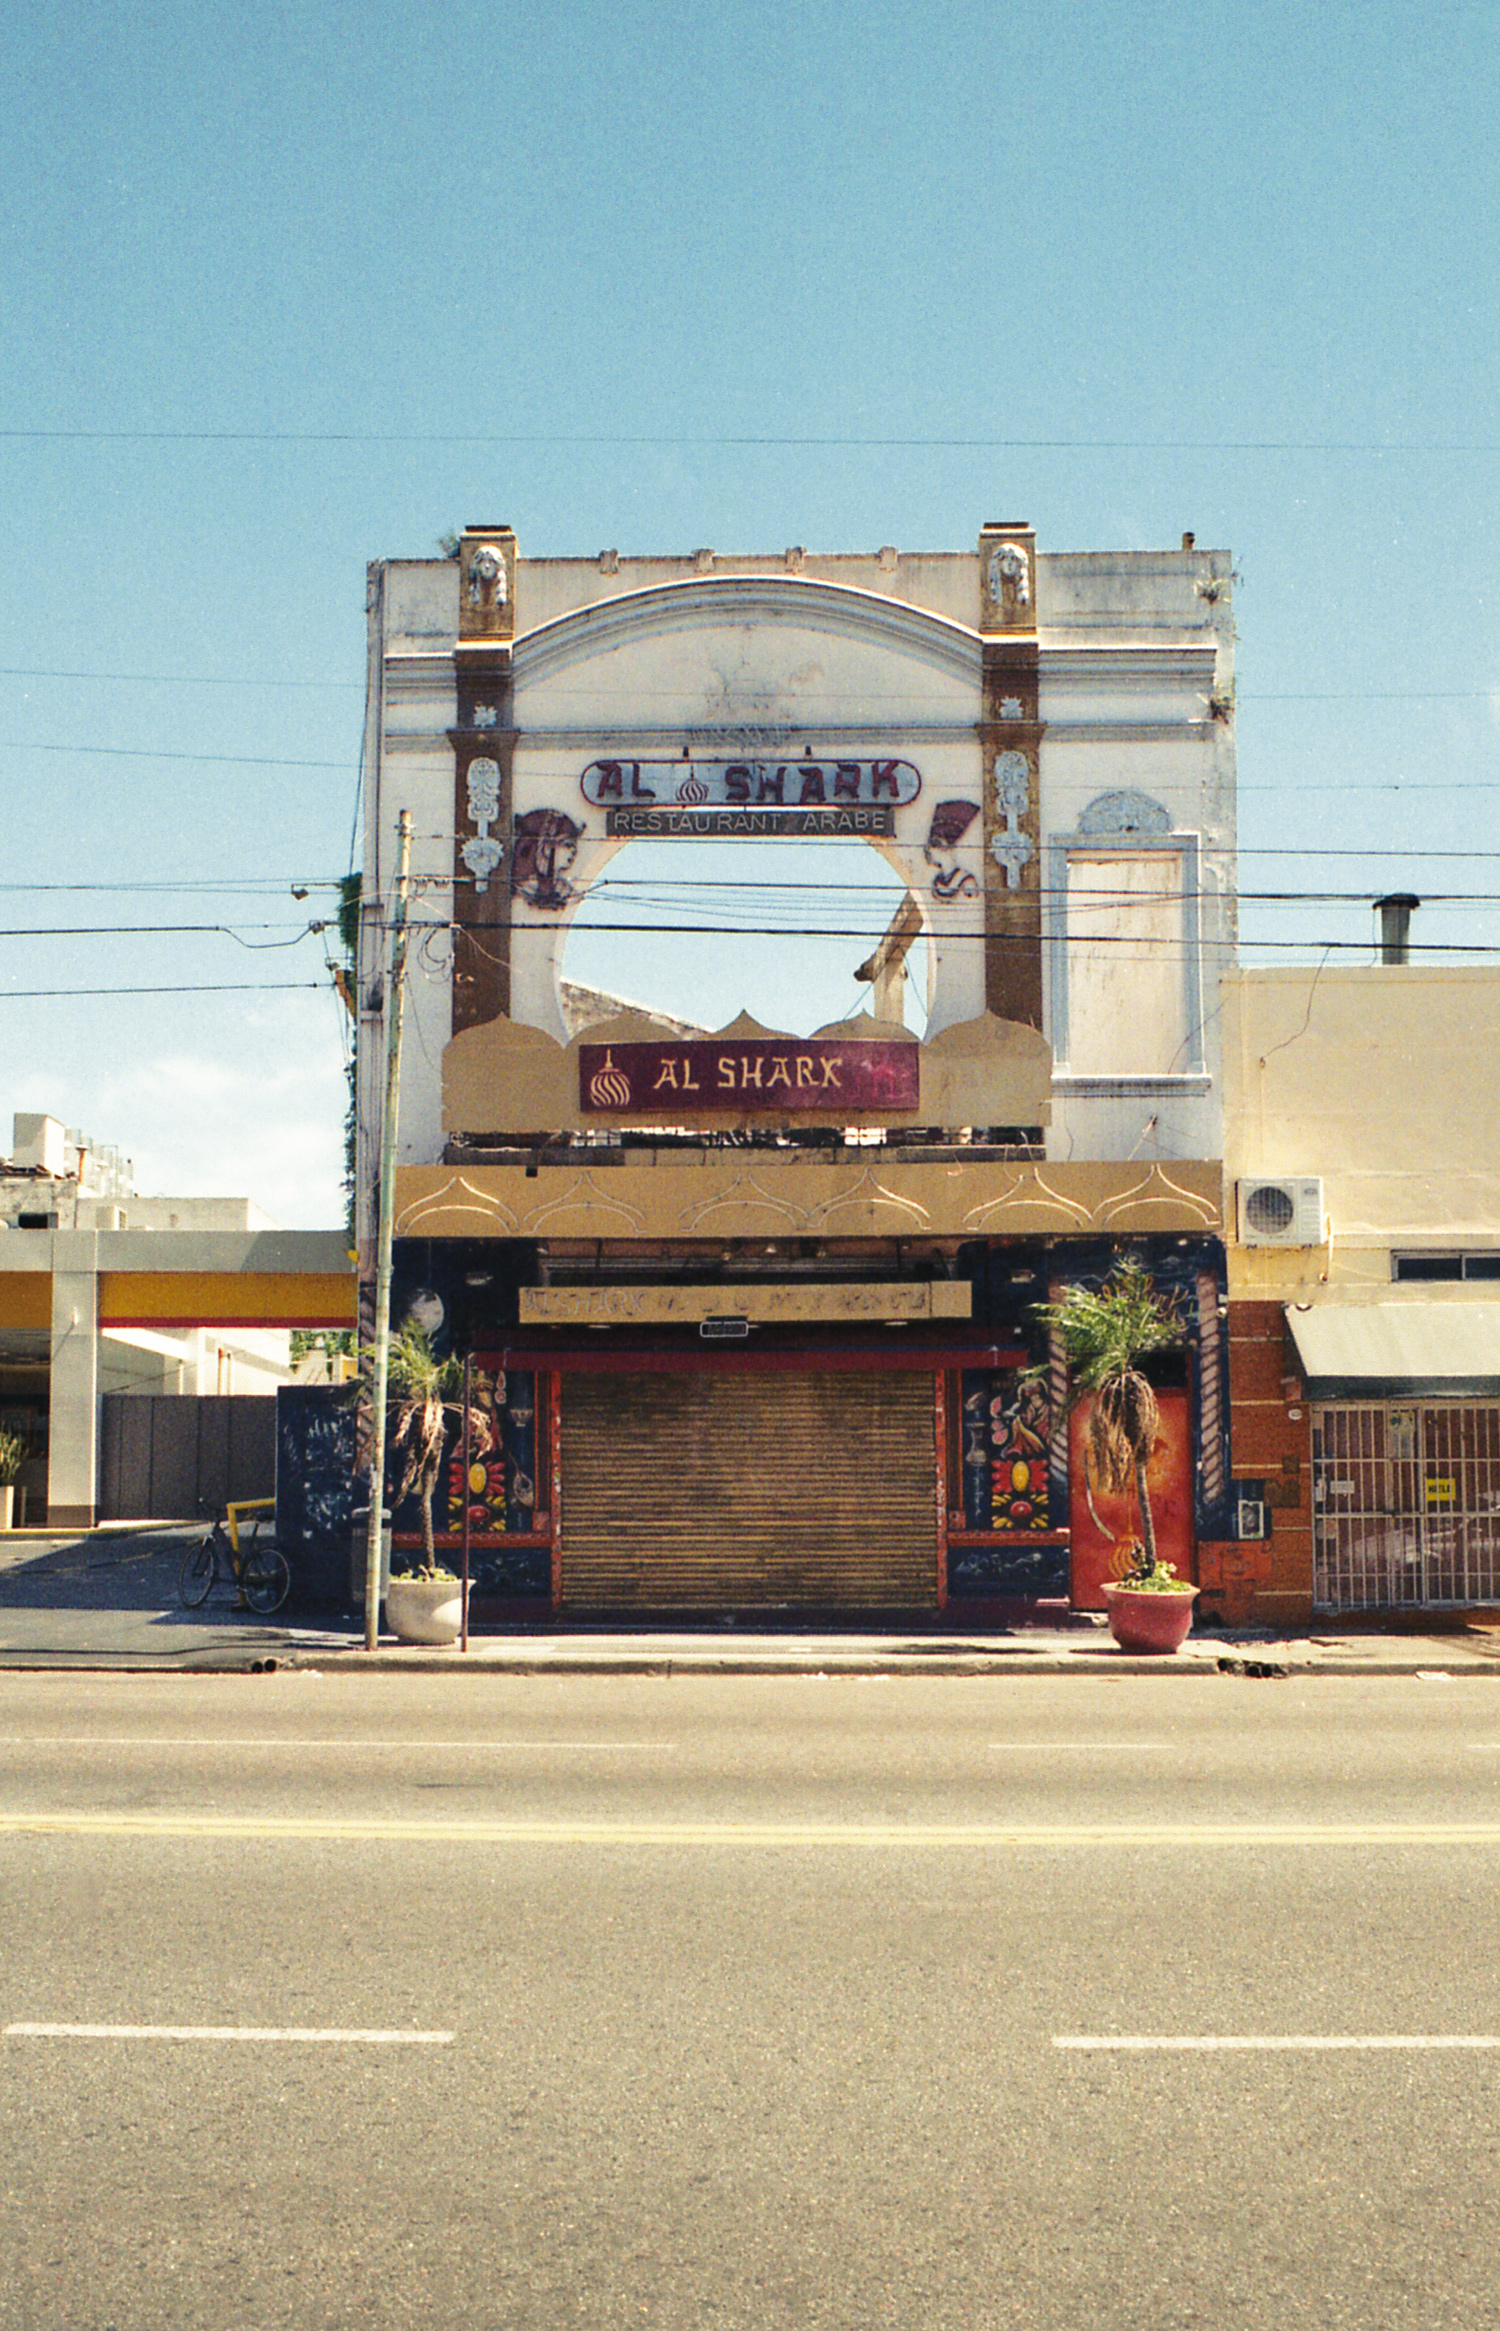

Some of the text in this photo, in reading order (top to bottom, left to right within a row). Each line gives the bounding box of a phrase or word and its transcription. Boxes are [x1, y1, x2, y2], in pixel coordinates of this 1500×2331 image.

[596, 760, 901, 803] AL SHARK
[613, 811, 886, 833] RESTAURANT ARABE
[653, 1055, 843, 1090] AL SHARK
